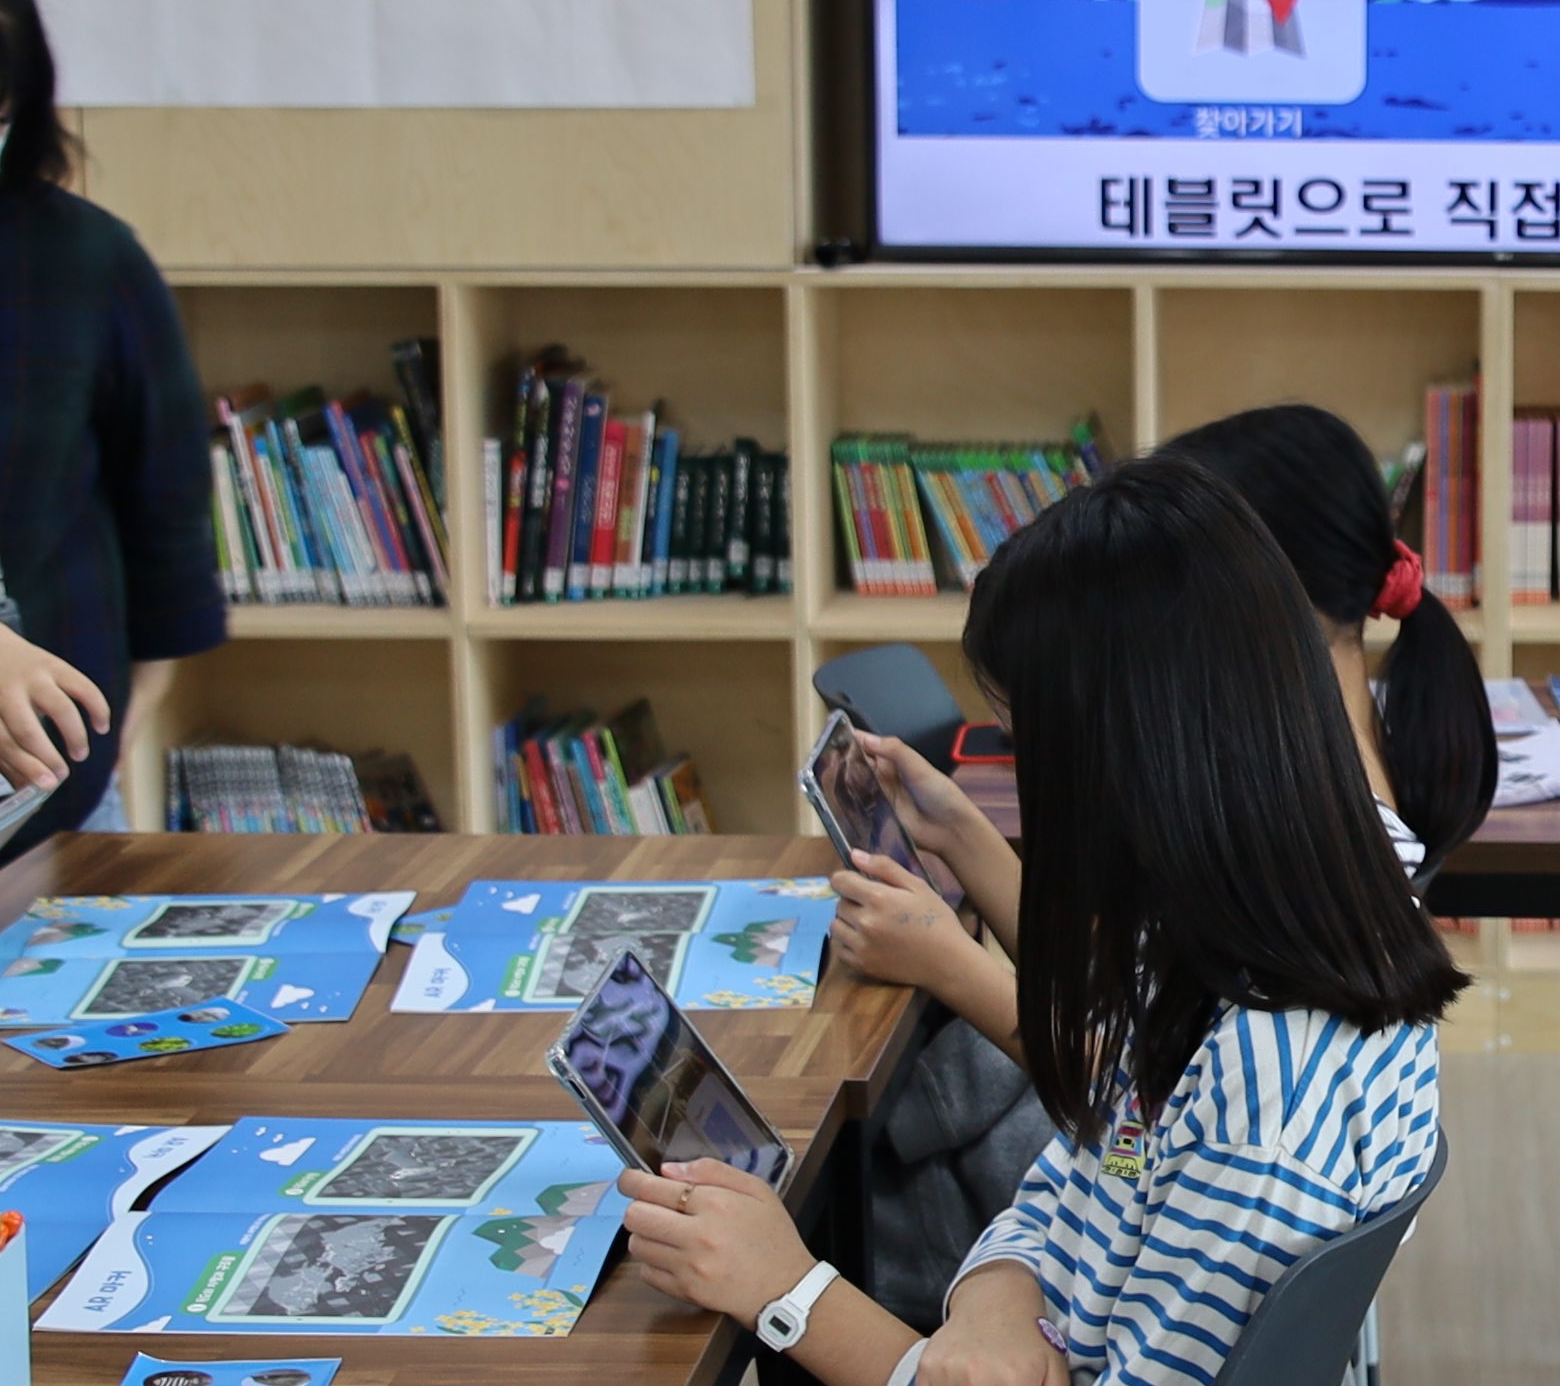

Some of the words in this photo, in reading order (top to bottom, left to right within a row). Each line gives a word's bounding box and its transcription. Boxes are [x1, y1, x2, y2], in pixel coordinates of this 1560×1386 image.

[1193, 106, 1304, 139] 찾아가기
[1097, 176, 1416, 240] 테블릿으로
[83, 1289, 113, 1313] AR
[101, 1269, 133, 1292] 마커
